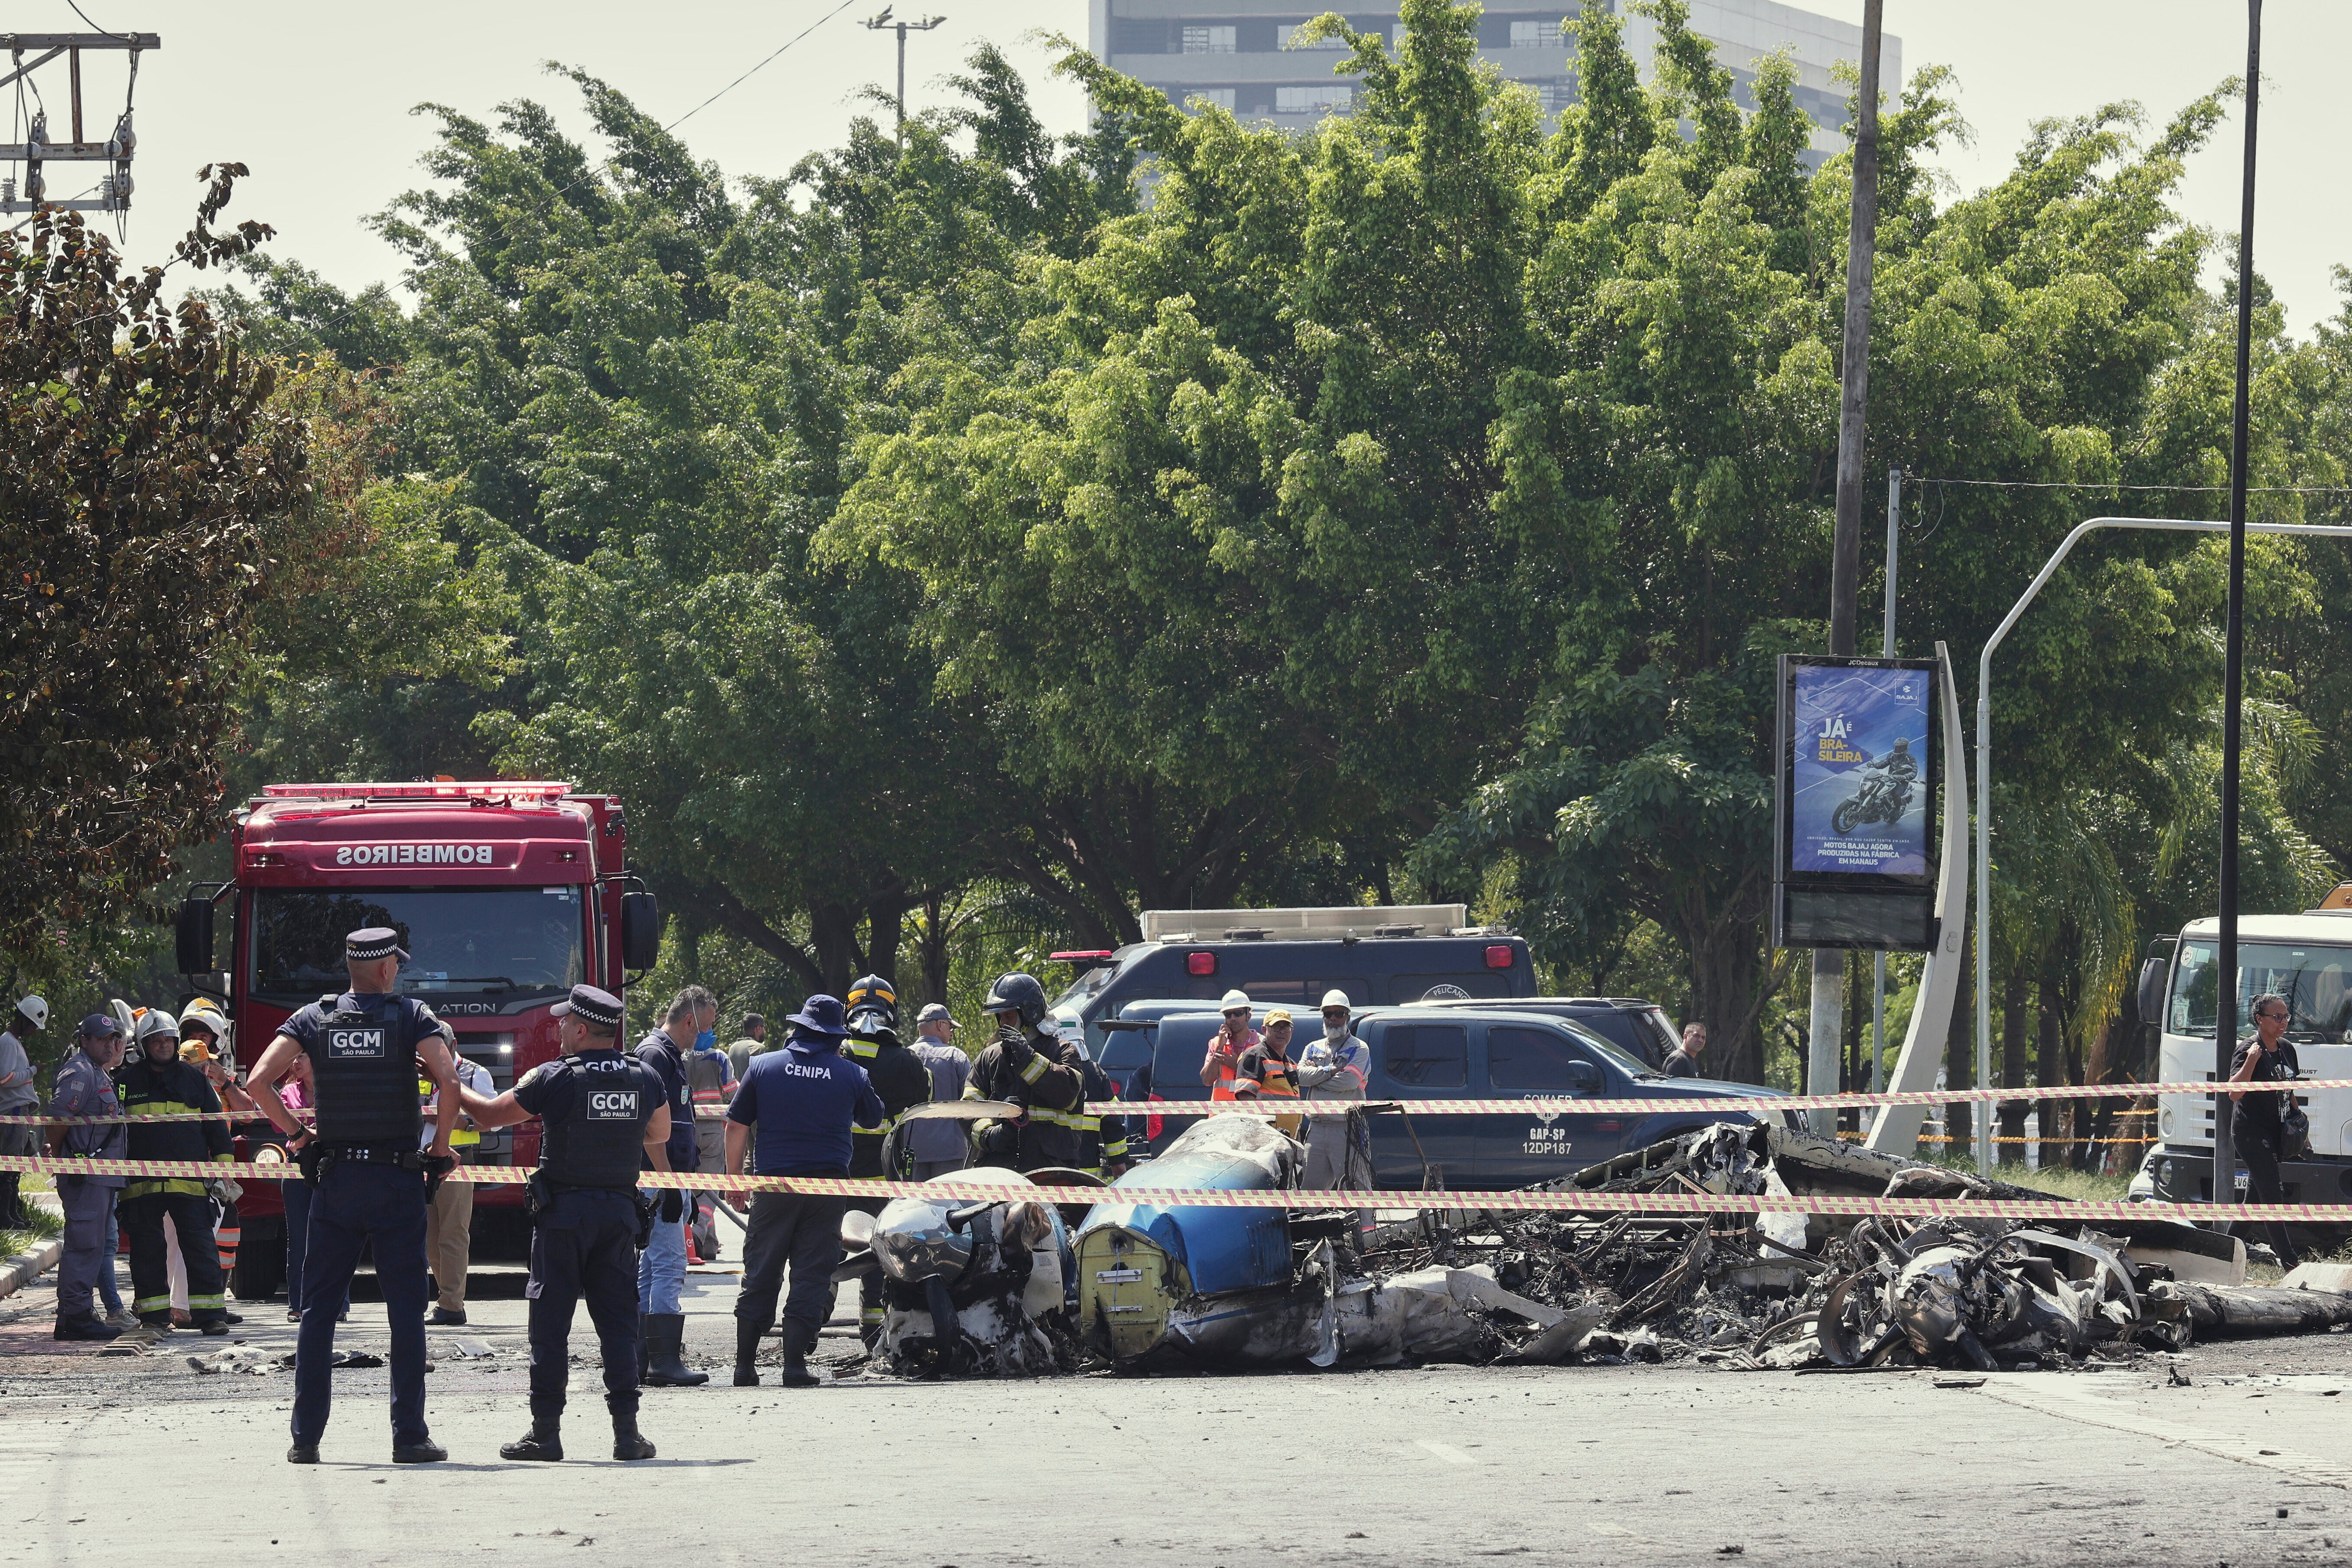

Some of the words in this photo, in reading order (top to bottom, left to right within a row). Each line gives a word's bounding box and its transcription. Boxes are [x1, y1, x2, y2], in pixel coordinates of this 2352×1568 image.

[1818, 714, 1847, 738] JÁ
[1847, 722, 1852, 731] É
[1820, 738, 1848, 750] BRA-
[1818, 750, 1862, 762] SILEIRA
[333, 1031, 380, 1048] GCM
[585, 1059, 627, 1071] GCM
[785, 1064, 831, 1079] CENIPA
[592, 1094, 635, 1109] GCM
[1530, 1128, 1565, 1140] GAP-SP
[1523, 1142, 1571, 1154] 12DP187
